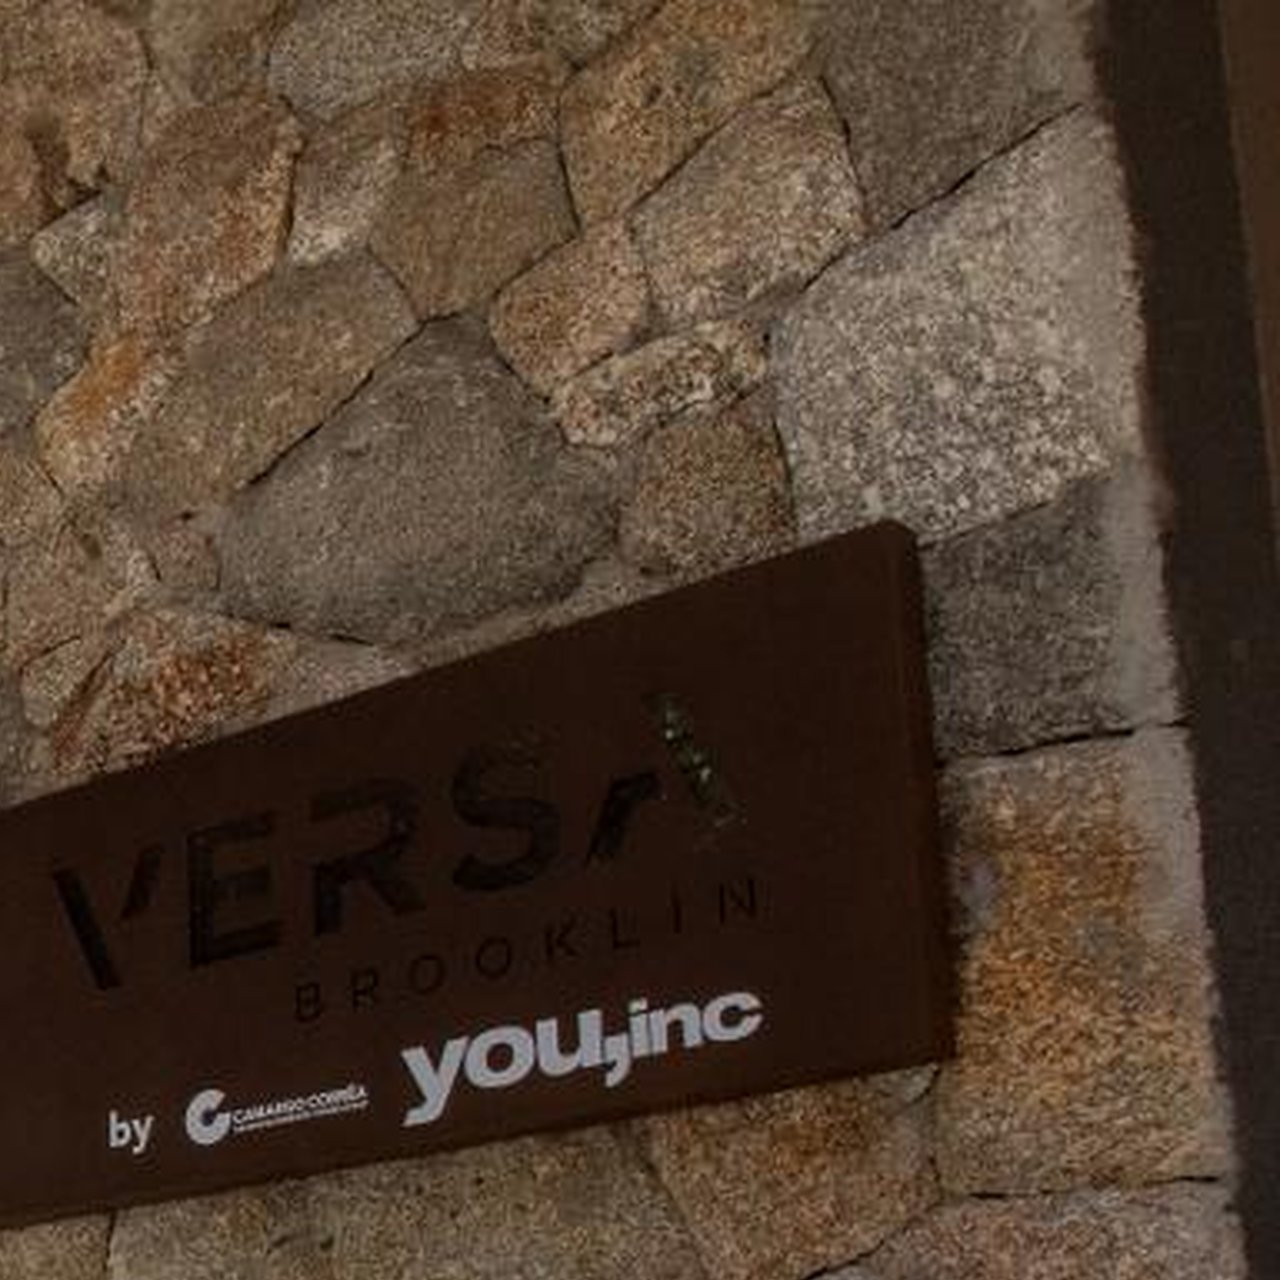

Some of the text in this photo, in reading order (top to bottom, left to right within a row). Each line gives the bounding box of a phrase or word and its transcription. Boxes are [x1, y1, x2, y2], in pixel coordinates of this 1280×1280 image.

[51, 692, 746, 990] VERSA
[294, 877, 760, 1022] BROOKLIN
[108, 1109, 154, 1154] by
